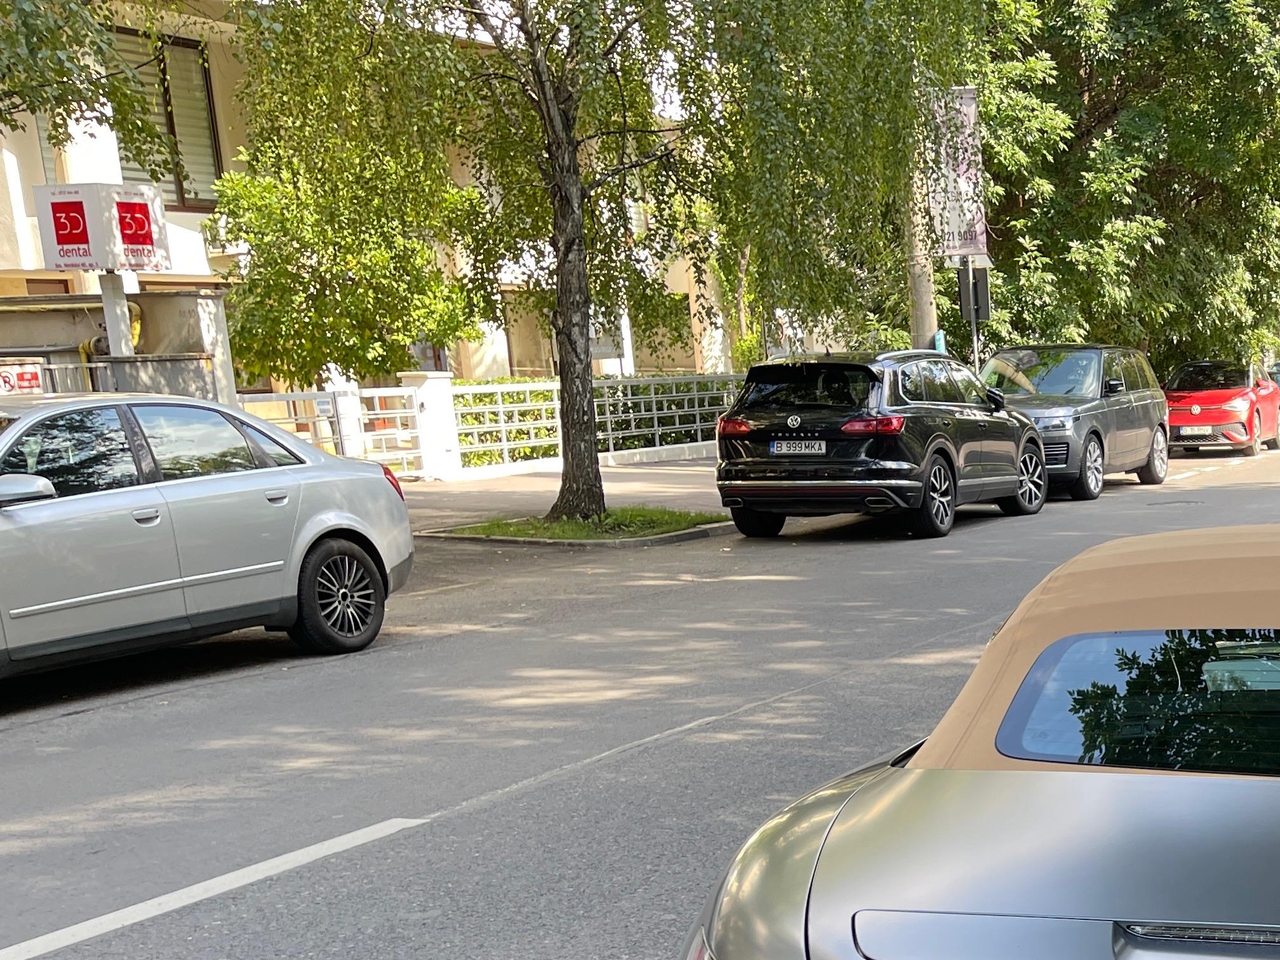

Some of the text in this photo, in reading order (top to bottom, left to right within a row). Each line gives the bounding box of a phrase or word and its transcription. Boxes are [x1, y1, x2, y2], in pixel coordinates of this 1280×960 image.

[957, 230, 977, 241] 9097
[58, 245, 92, 258] dental
[123, 245, 156, 258] dental
[776, 442, 823, 452] B 999 MKA
